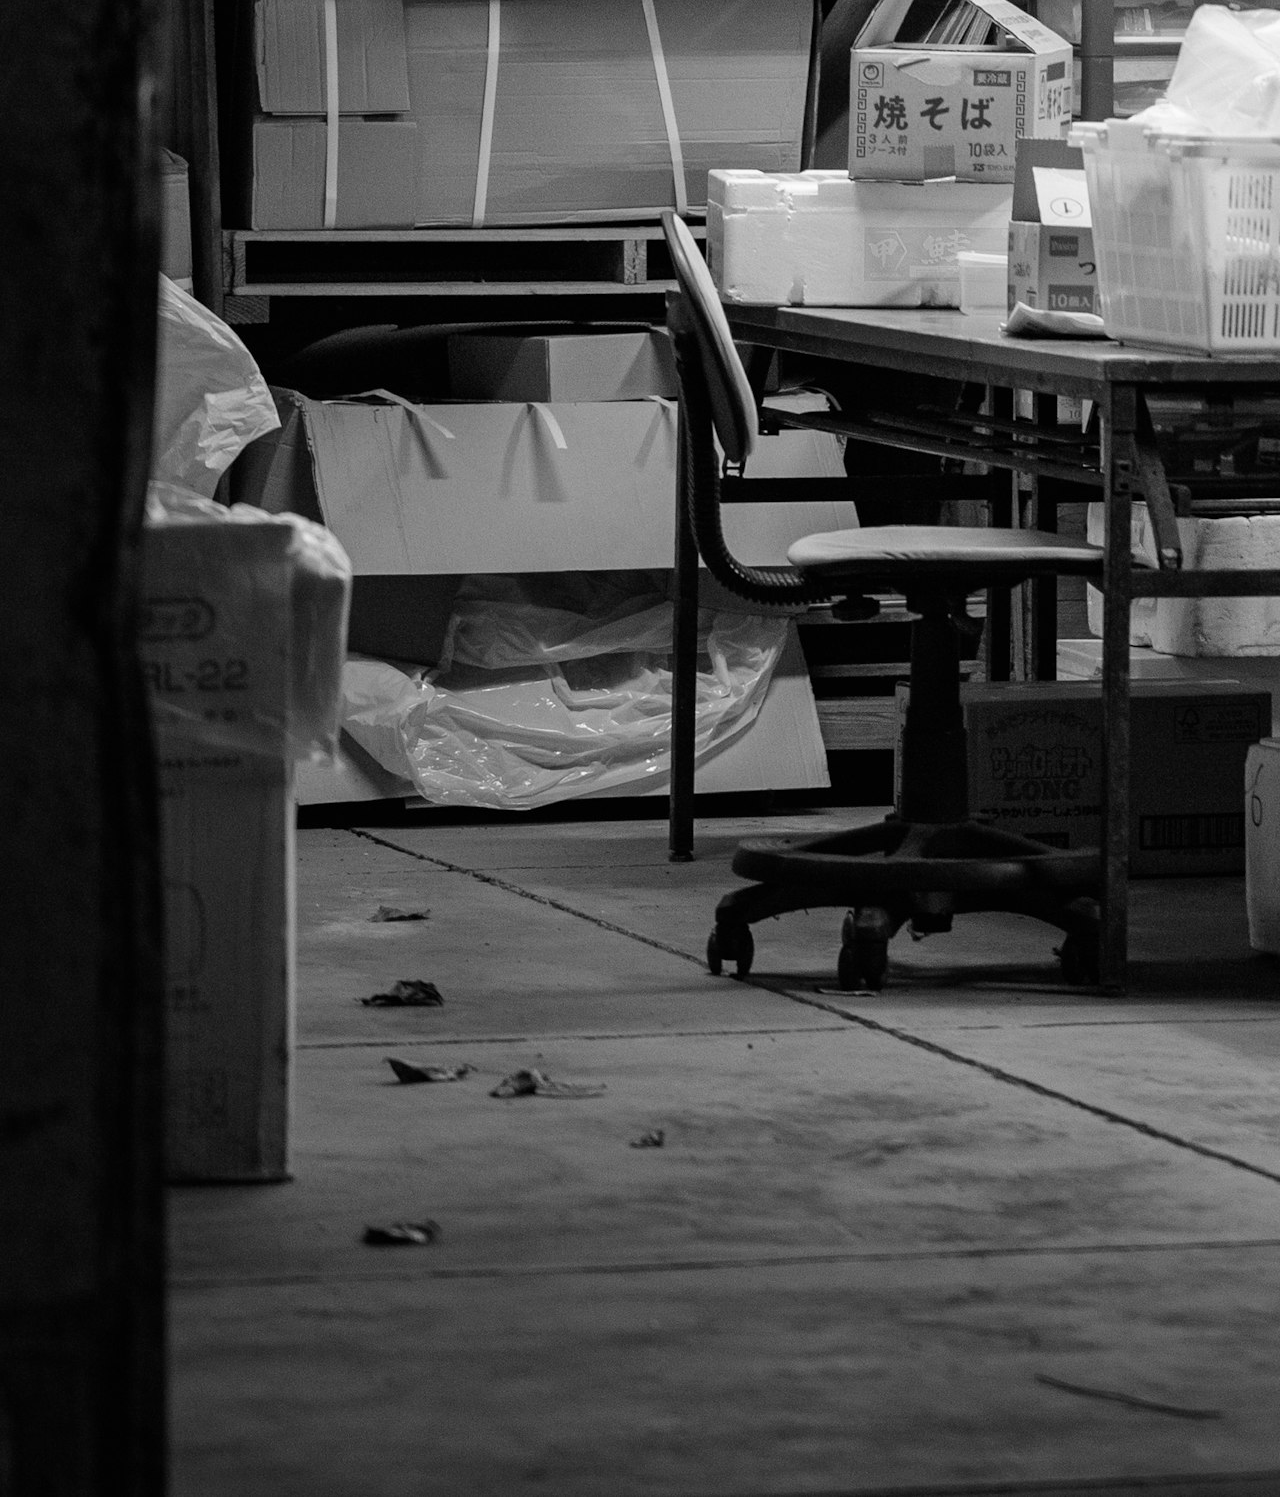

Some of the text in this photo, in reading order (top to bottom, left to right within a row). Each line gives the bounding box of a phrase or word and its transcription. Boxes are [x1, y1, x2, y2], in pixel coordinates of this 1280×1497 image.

[873, 95, 995, 131] 焼そば
[1004, 779, 1081, 801] LONG
